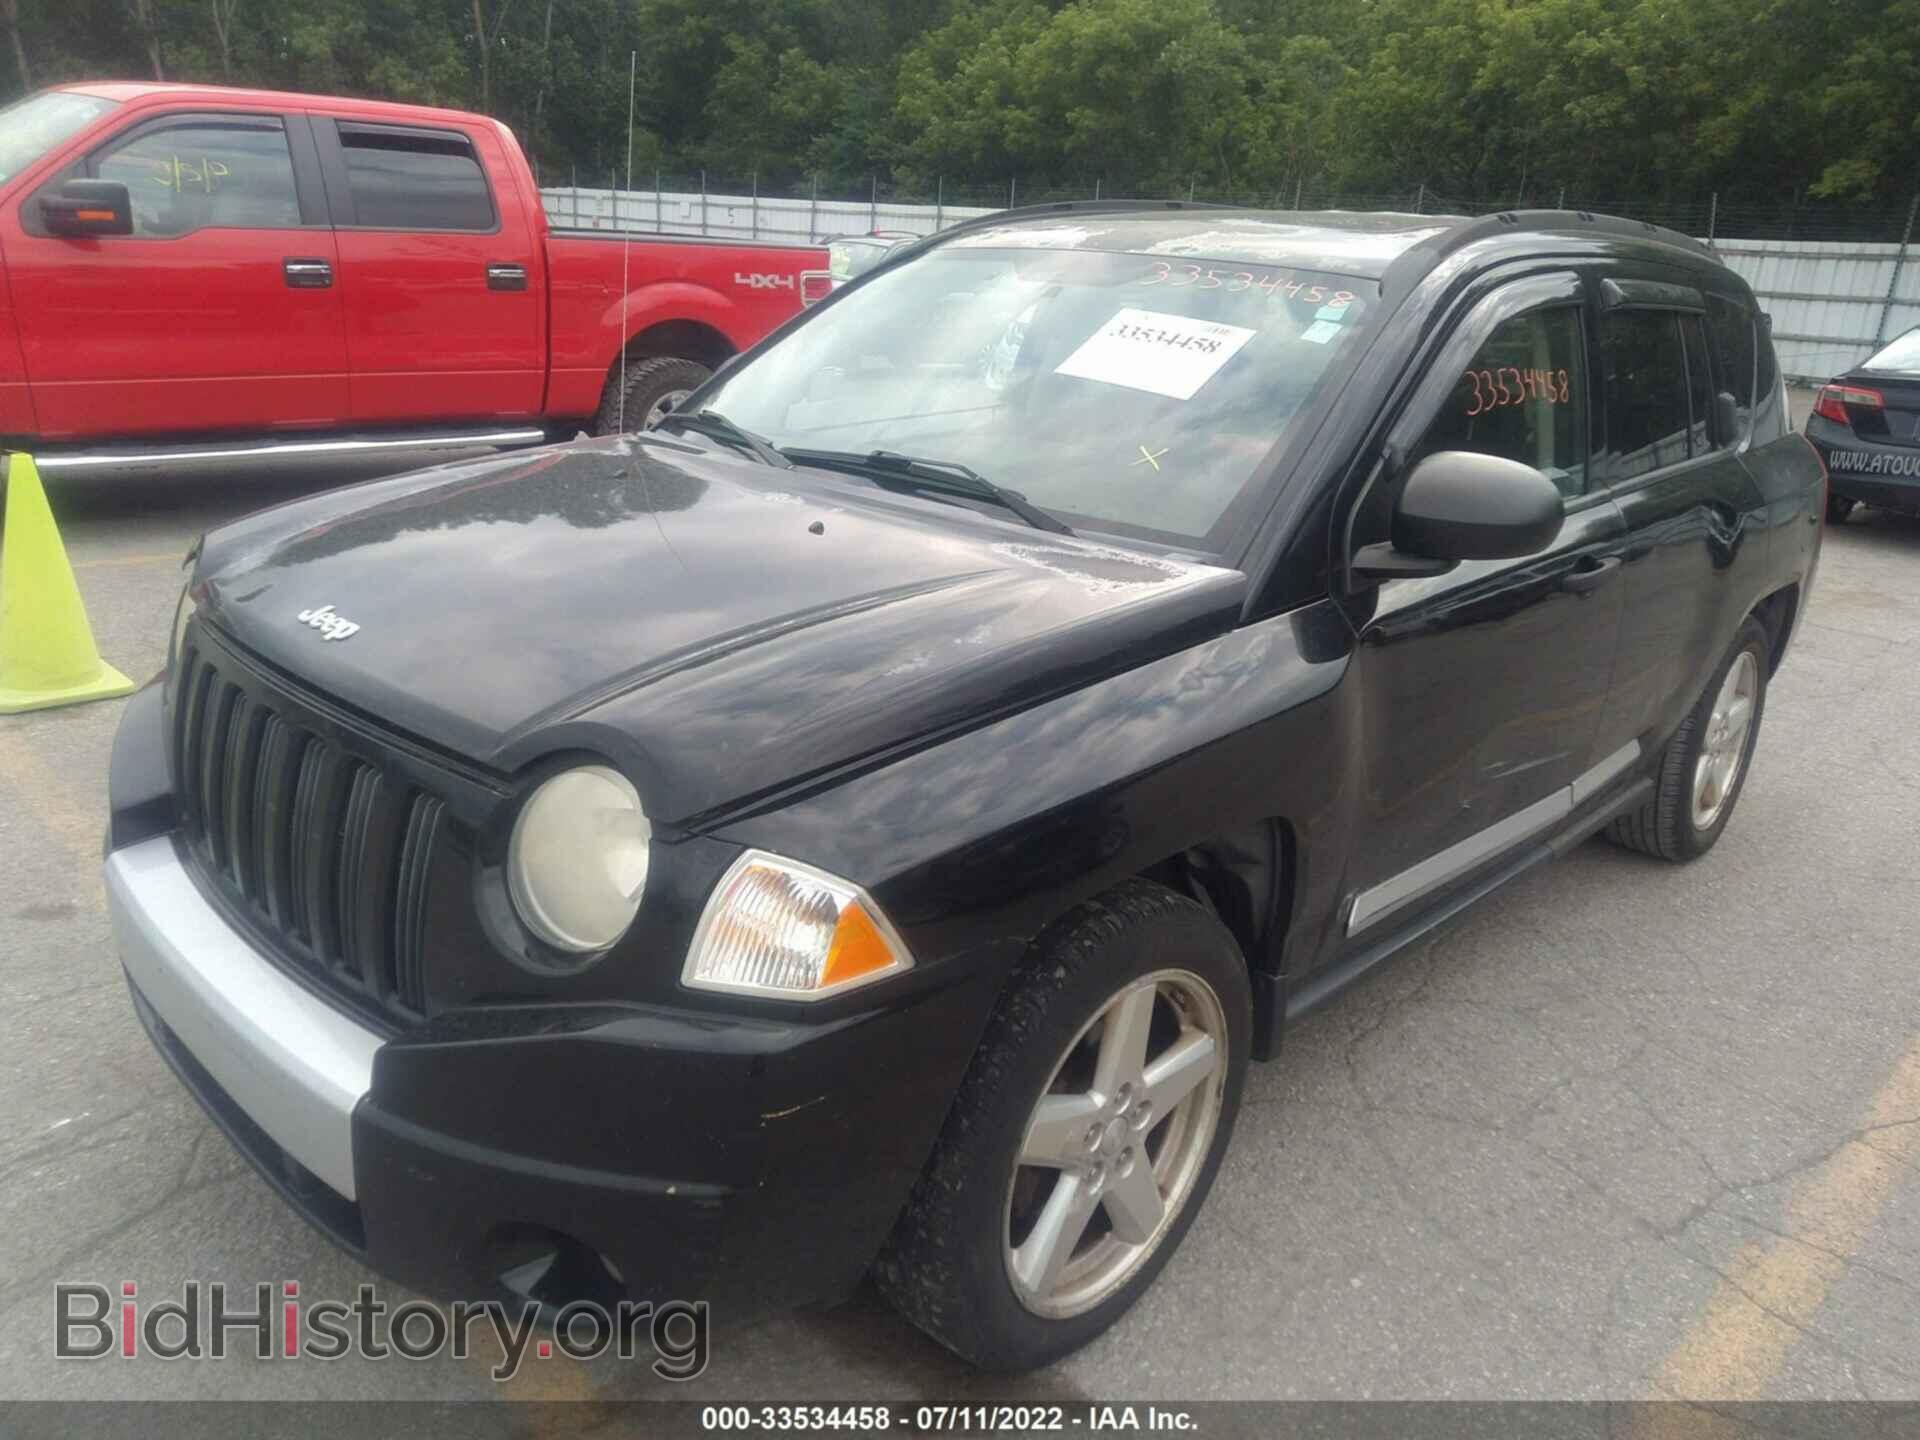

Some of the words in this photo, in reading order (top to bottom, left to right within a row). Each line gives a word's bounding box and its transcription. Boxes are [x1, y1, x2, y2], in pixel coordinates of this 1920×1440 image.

[734, 272, 794, 289] 4X4
[1140, 261, 1355, 309] 33534458
[1464, 367, 1569, 416] 33534458
[298, 604, 360, 640] Jeep
